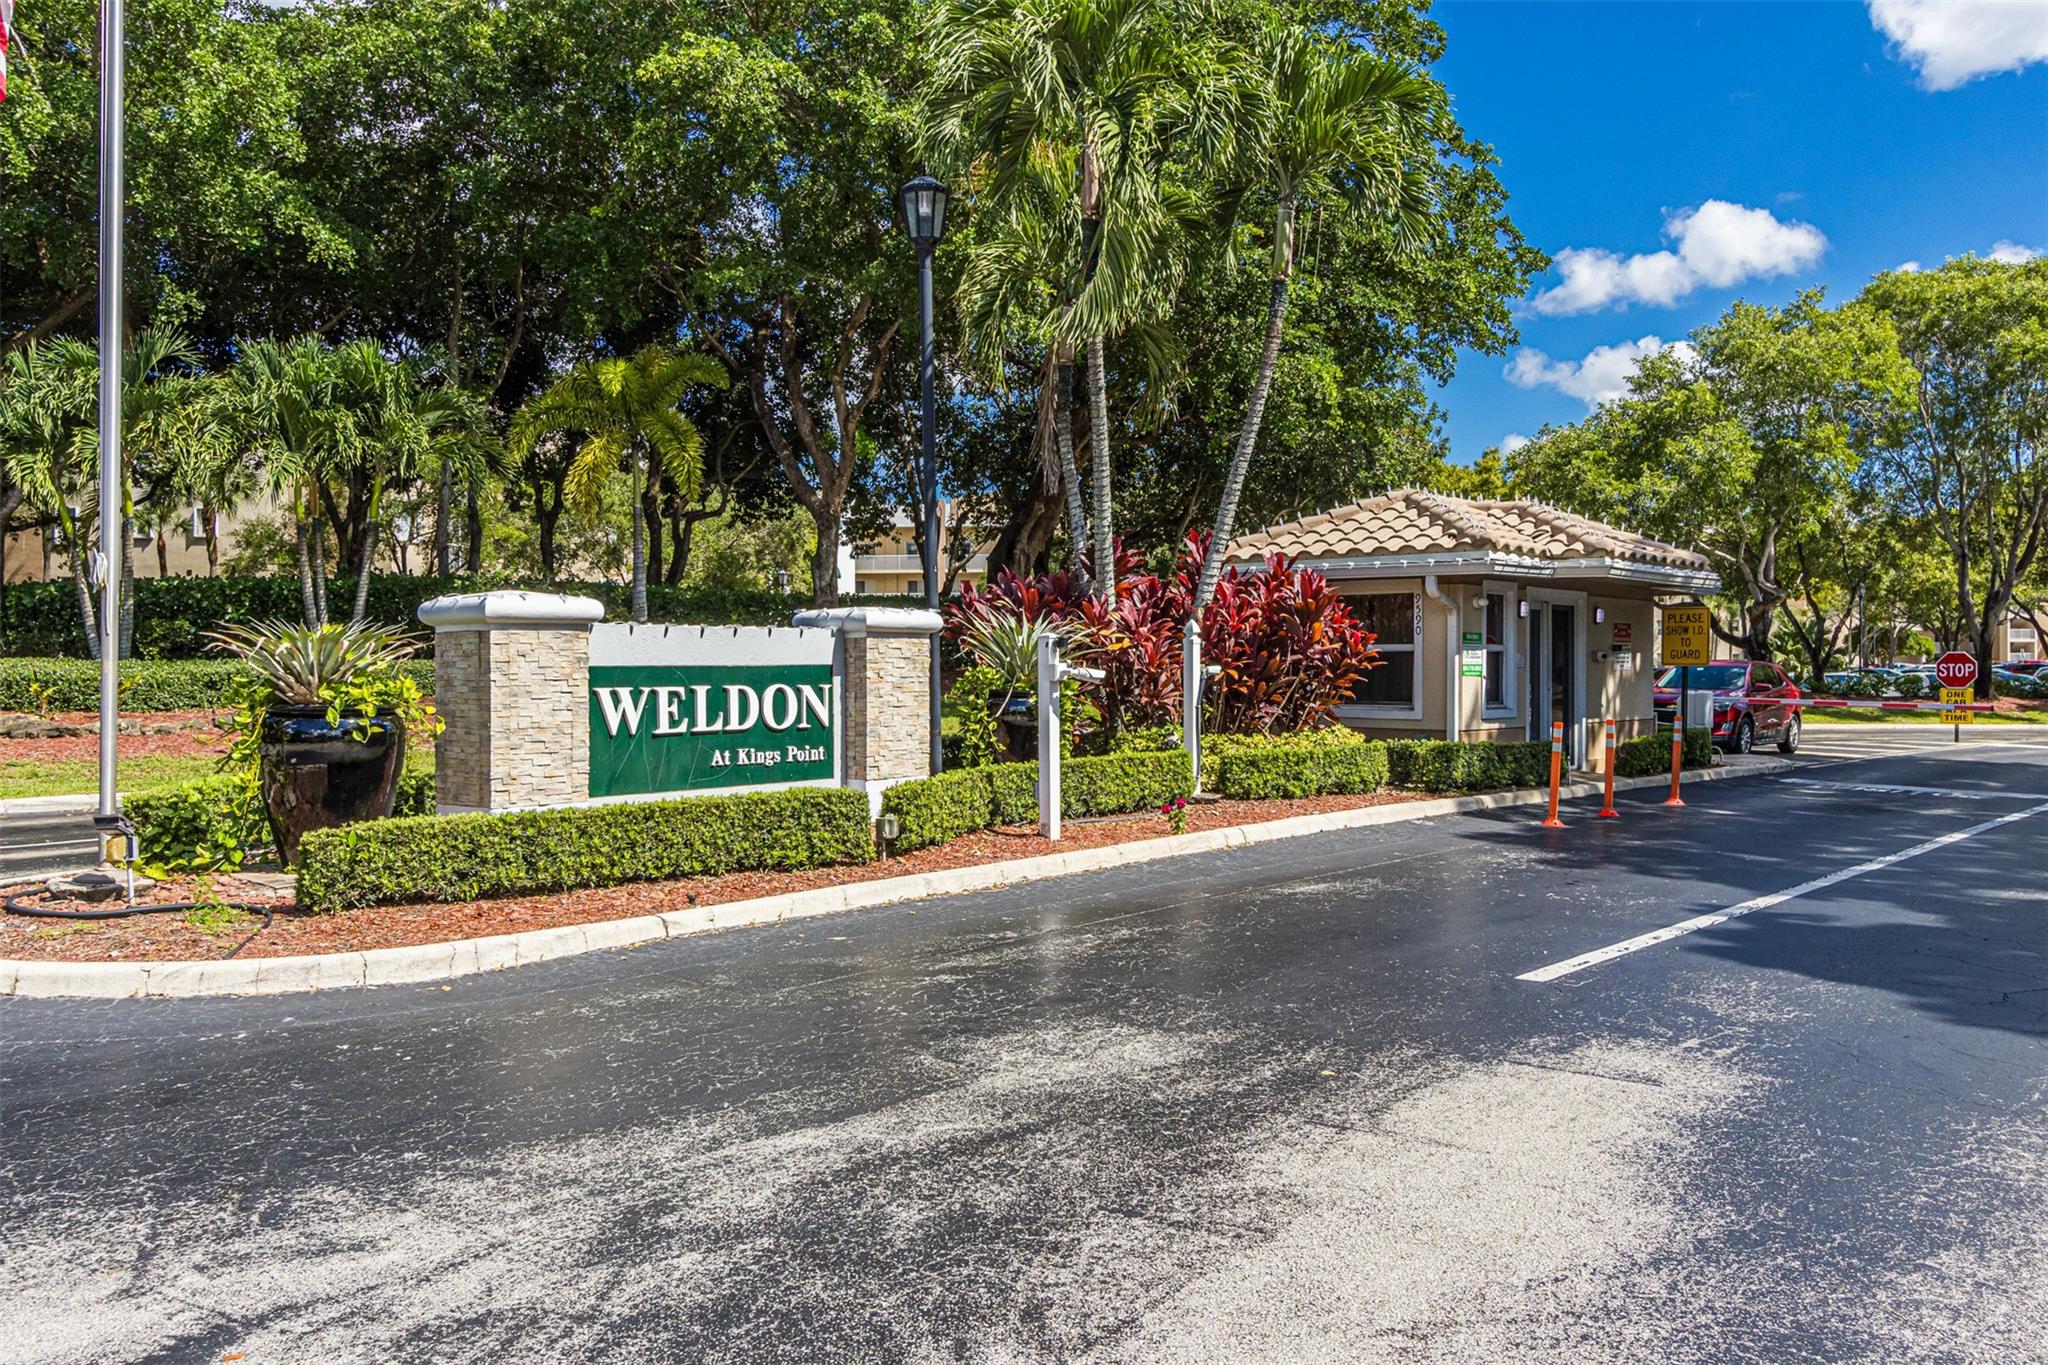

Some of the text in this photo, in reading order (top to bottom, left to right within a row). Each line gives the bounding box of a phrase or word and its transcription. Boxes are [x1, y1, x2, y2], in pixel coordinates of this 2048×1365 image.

[1667, 613, 1704, 623] PLEASE
[1665, 625, 1706, 636] SHOW I.D.
[1680, 637, 1691, 647] TO
[1670, 649, 1700, 660] GUARD
[1939, 663, 1974, 678] STOP
[592, 684, 833, 738] WELDON
[710, 745, 826, 768] At Kings Point
